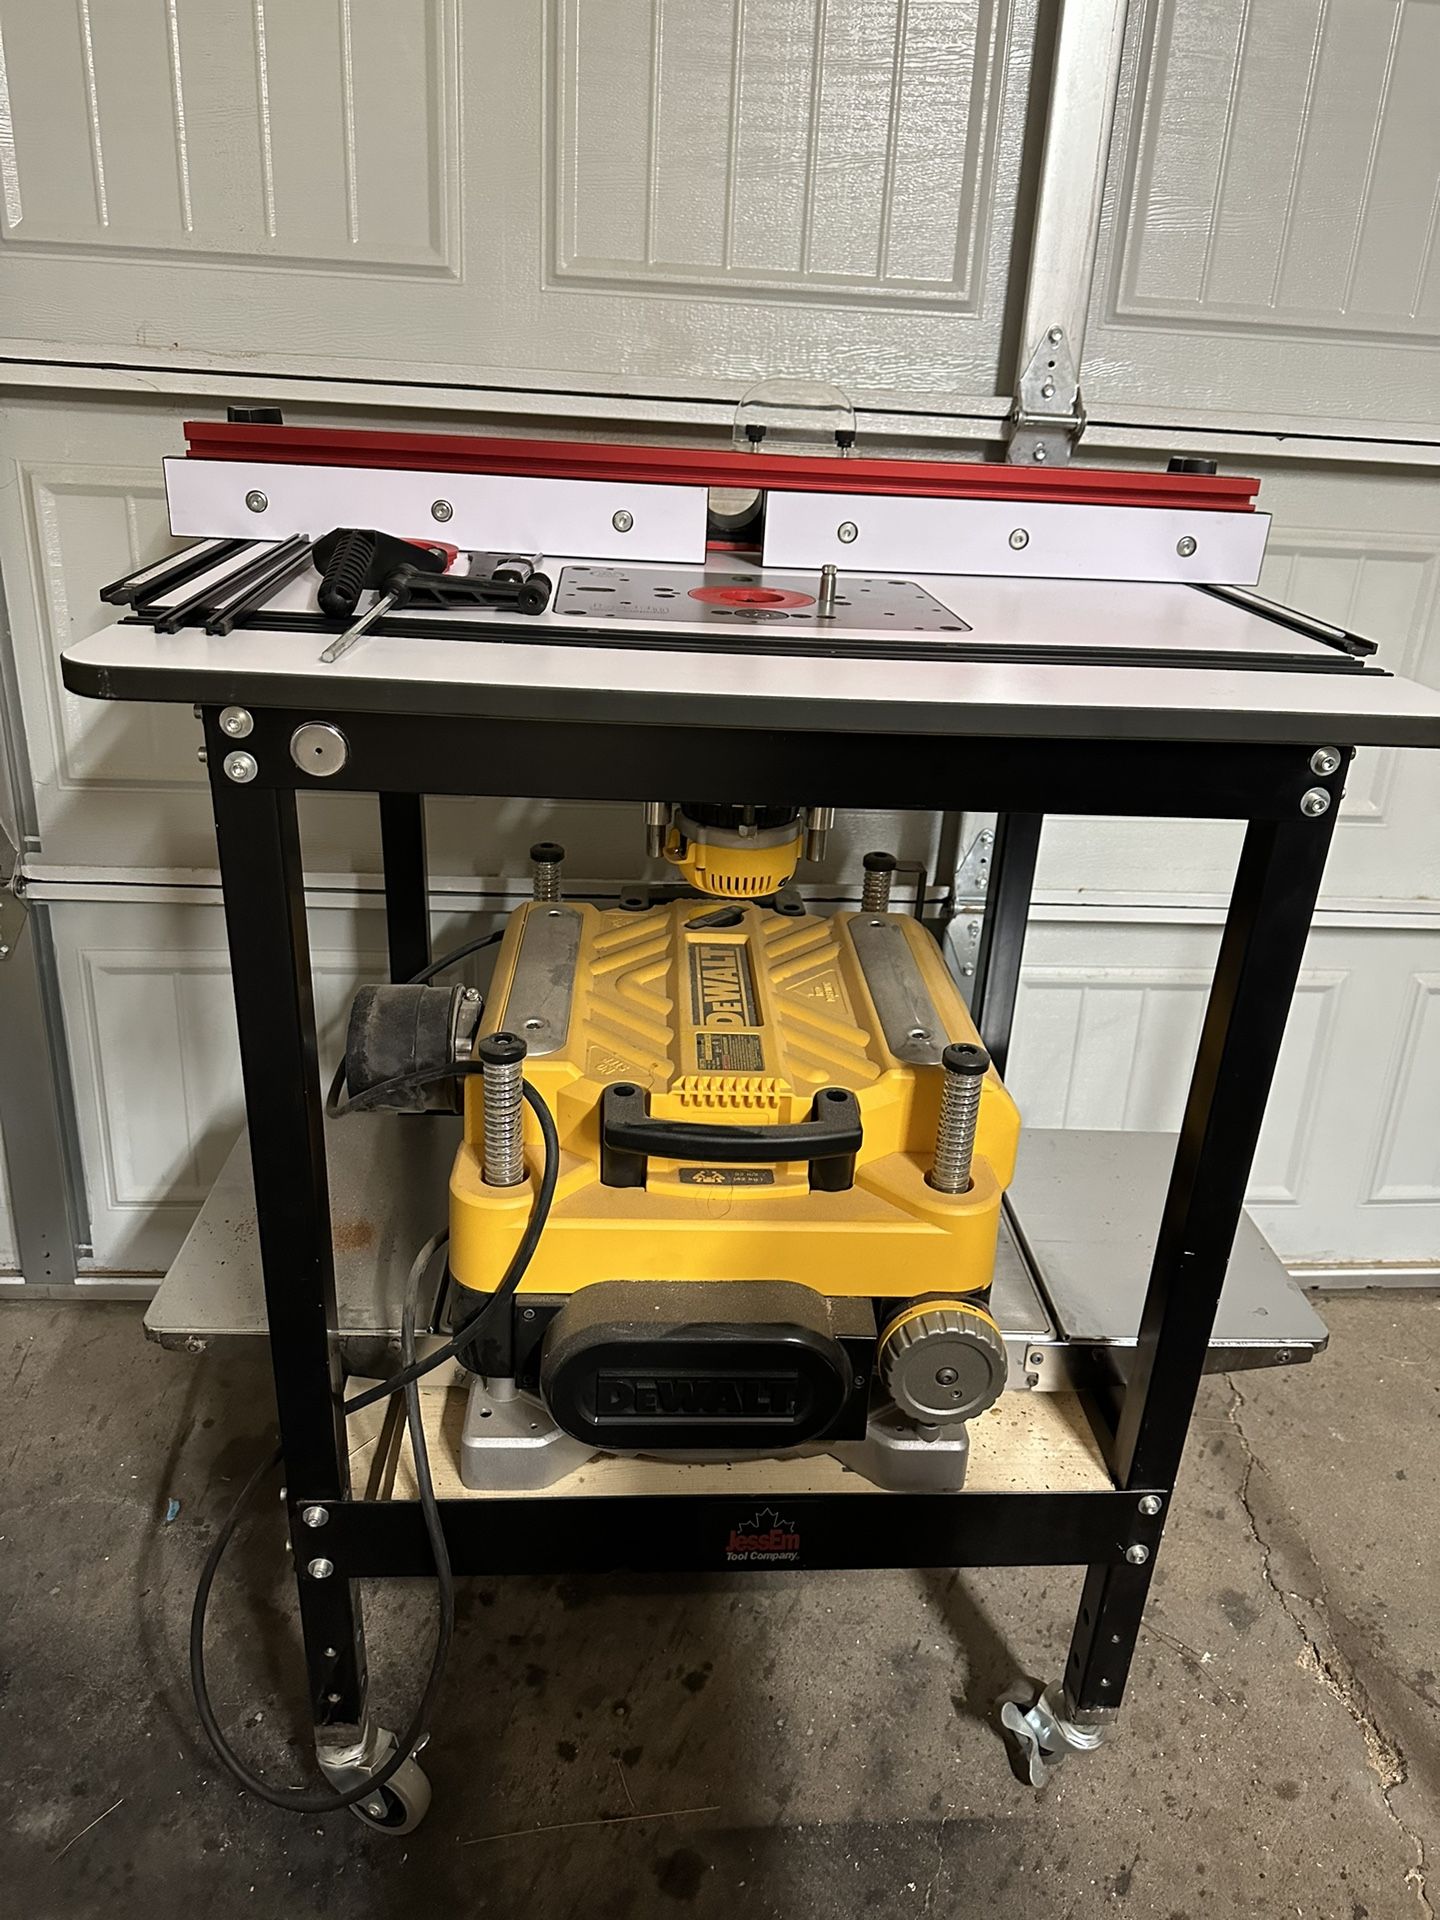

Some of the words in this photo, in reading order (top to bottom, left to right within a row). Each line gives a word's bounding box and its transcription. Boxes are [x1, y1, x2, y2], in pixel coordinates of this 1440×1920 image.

[700, 946, 745, 1027] DEWALT
[725, 1529, 800, 1552] JessEm
[726, 1551, 748, 1561] Tool
